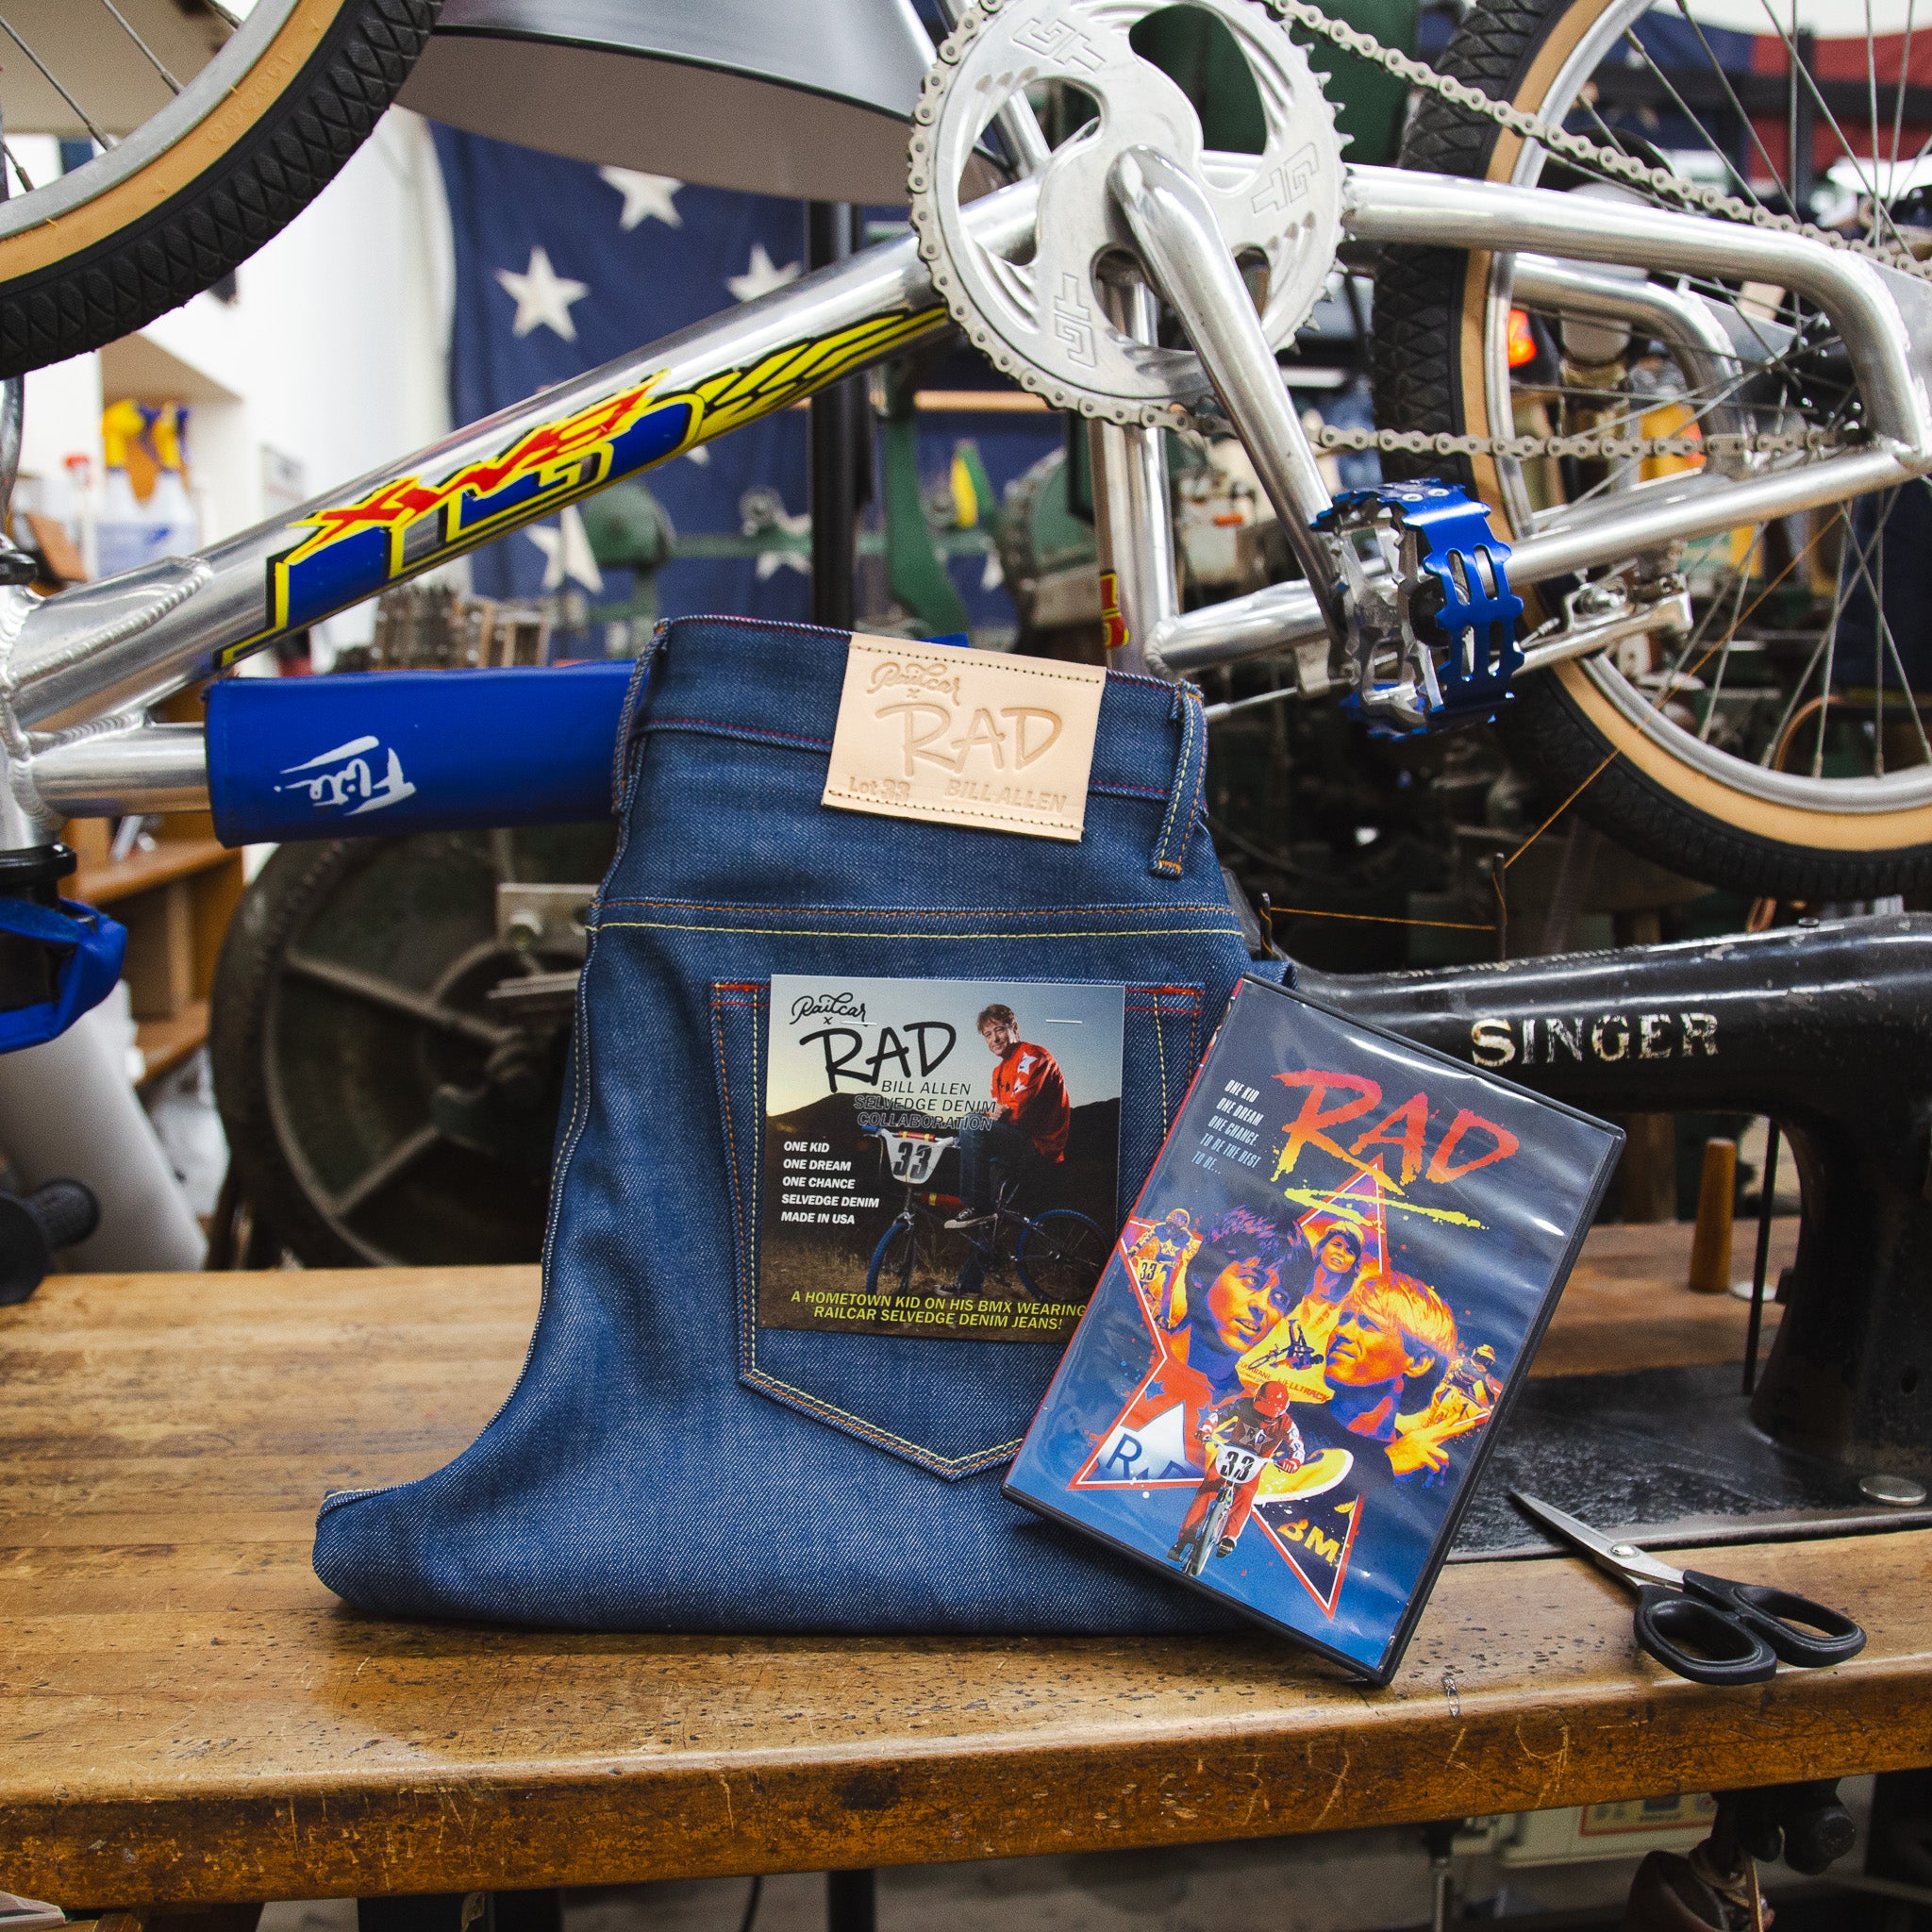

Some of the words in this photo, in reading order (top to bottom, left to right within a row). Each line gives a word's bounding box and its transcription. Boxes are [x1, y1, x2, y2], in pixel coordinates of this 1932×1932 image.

[865, 661, 960, 707] Railcar
[874, 702, 1063, 777] RAD
[849, 776, 877, 795] Lot
[945, 778, 991, 802] BILL
[996, 786, 1068, 814] ALLEN
[790, 991, 869, 1026] Railcar
[1471, 1011, 1720, 1068] SINGER
[799, 1021, 958, 1093] RAD
[881, 1080, 915, 1093] BILL
[920, 1081, 972, 1095] ALLEN
[1224, 1079, 1245, 1096] ONE
[1241, 1086, 1260, 1103] KID
[853, 1094, 938, 1111] SELVEDGE
[942, 1099, 997, 1113] DENIM
[1216, 1097, 1237, 1114] ONE
[1232, 1104, 1265, 1126] DREAM
[857, 1111, 993, 1131] COLLABORATION
[1208, 1115, 1228, 1132] ONE
[1270, 1068, 1521, 1197] RAD
[783, 1141, 808, 1152] ONE
[809, 1141, 830, 1153] KID
[1191, 1151, 1207, 1165] TO
[1200, 1132, 1214, 1147] TO
[1210, 1138, 1226, 1153] BE
[1223, 1142, 1241, 1159] THE
[1238, 1150, 1262, 1169] BEST
[783, 1158, 808, 1170] ONE
[808, 1159, 852, 1172] DREAM
[892, 1141, 934, 1180] 33
[782, 1175, 808, 1187] ONE
[808, 1177, 857, 1190] CHANCE
[781, 1193, 840, 1207] SELVEDGE
[841, 1196, 880, 1208] DENIM
[780, 1211, 816, 1223] MADE
[817, 1212, 830, 1224] IN
[832, 1213, 856, 1224] USA
[1140, 1262, 1158, 1281] 33
[791, 1291, 801, 1303] A
[805, 1291, 891, 1307] HOMETOWN
[895, 1296, 921, 1309] KID
[924, 1297, 946, 1310] ON
[949, 1298, 974, 1312] HIS
[977, 1300, 1013, 1314] BMX
[1017, 1302, 1087, 1318] WEARING
[813, 1306, 877, 1321] RAILCAR
[880, 1309, 956, 1325] SELVEDGE
[958, 1313, 1008, 1328] DENIM
[1011, 1316, 1063, 1331] JEANS!
[1220, 1451, 1255, 1481] 33
